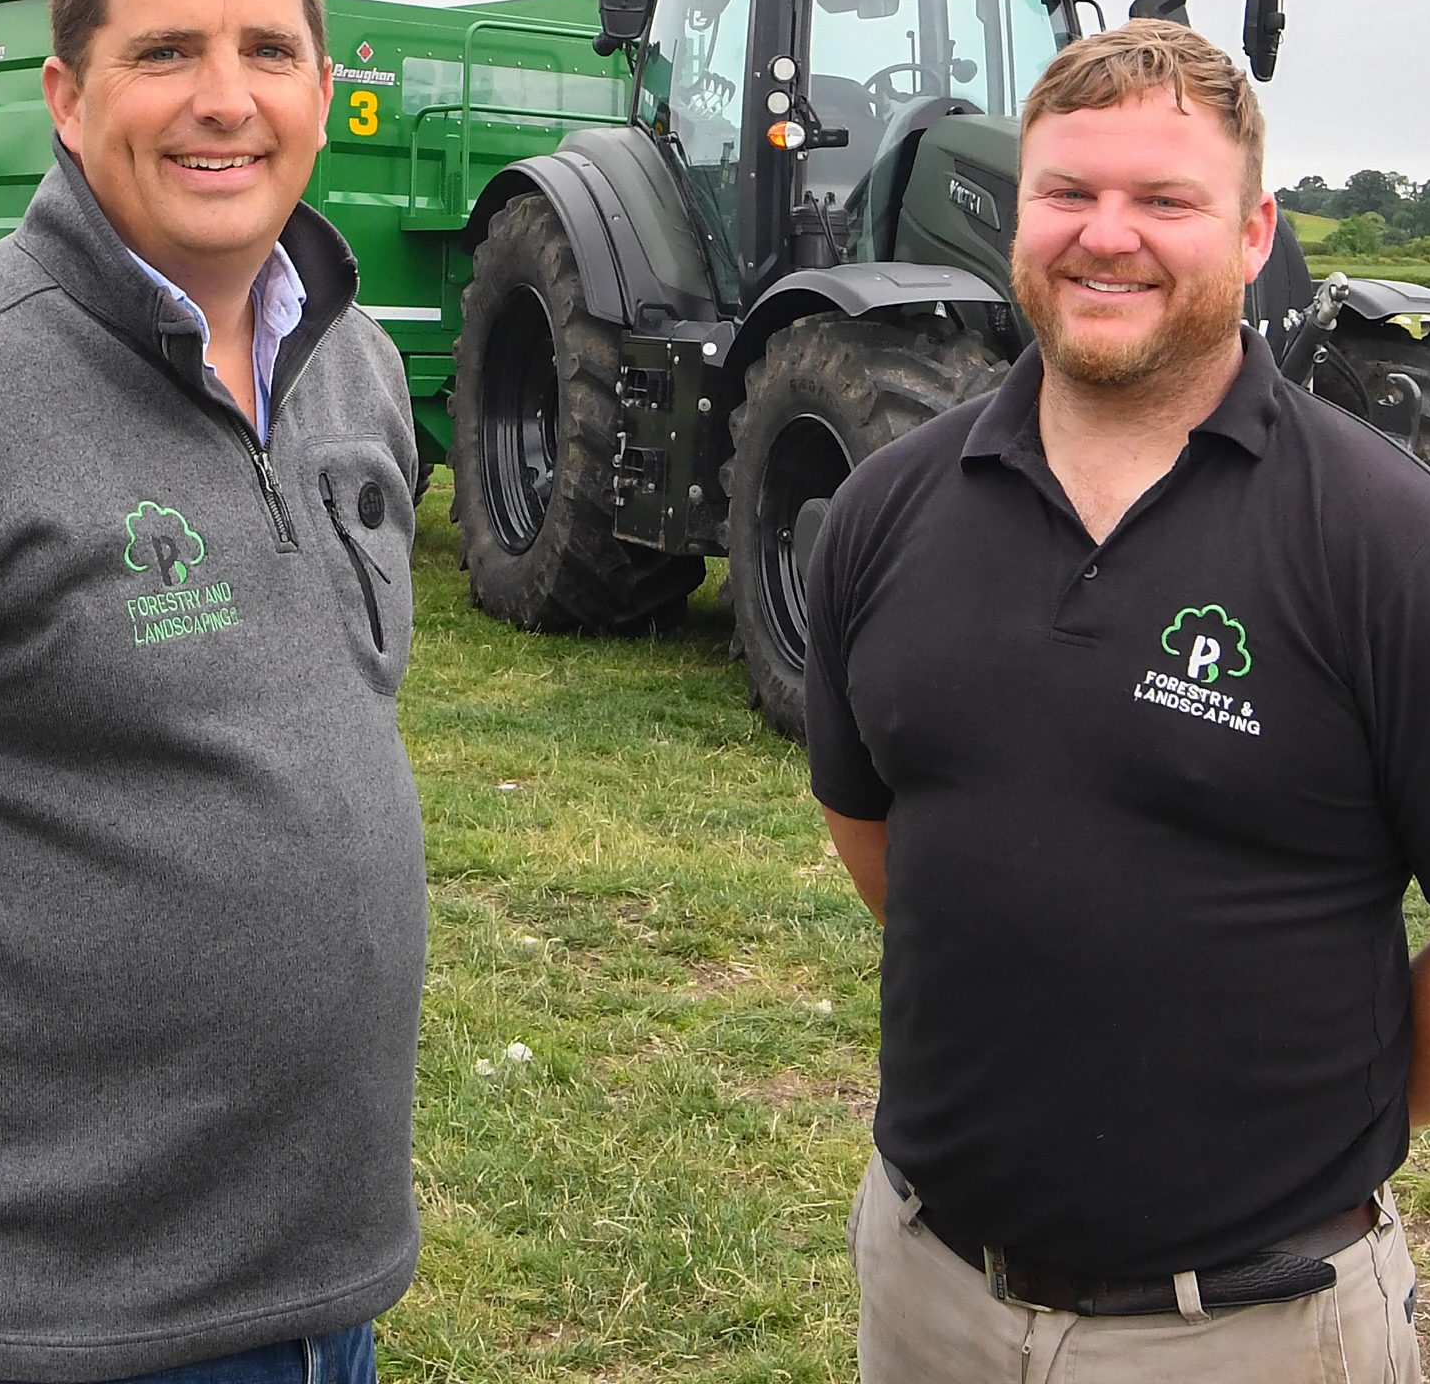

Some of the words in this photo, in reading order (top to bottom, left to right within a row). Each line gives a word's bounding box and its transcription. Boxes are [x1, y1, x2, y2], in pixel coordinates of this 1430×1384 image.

[349, 90, 378, 135] 3
[127, 589, 201, 622] FORESTRY
[206, 582, 232, 604] AND
[134, 607, 232, 645] LANDSCAPING
[1134, 683, 1261, 736] LANDSCAPING
[1144, 670, 1234, 710] FORESTRY
[1241, 701, 1253, 717] &
